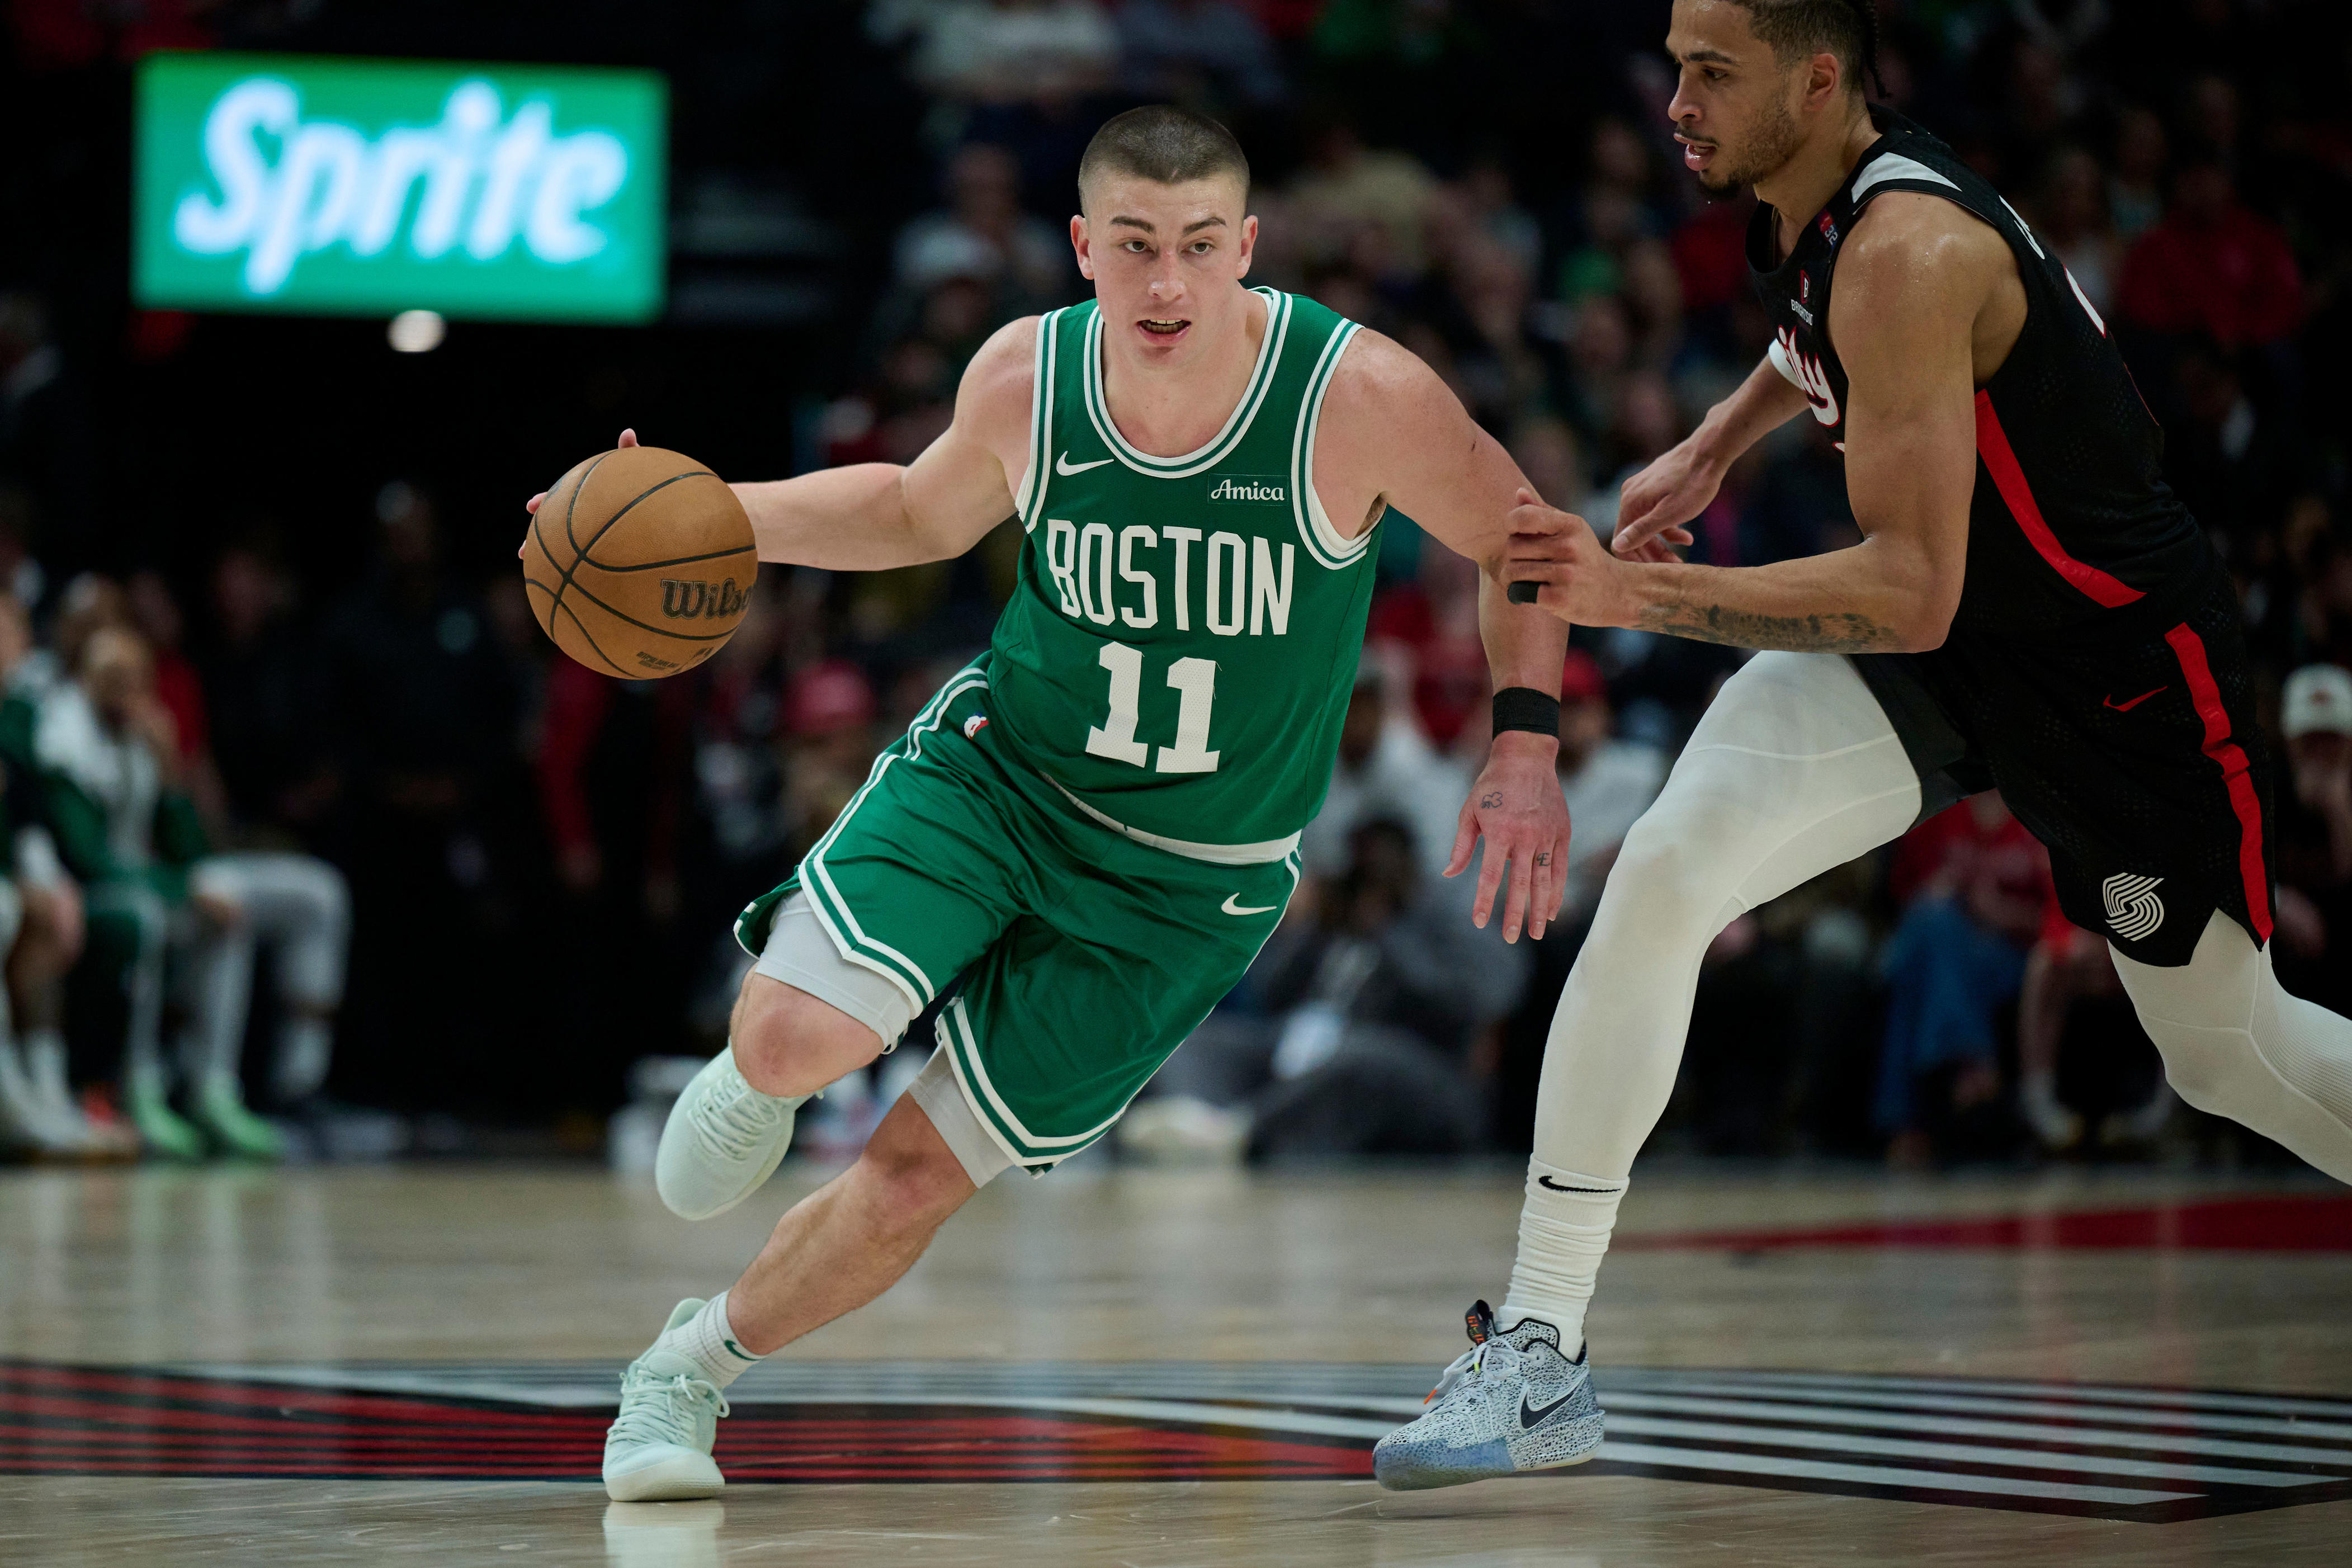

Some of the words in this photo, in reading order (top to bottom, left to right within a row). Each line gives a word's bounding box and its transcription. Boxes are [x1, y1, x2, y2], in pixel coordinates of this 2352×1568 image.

[175, 75, 627, 296] Sprite
[1825, 224, 1838, 245] 32
[1211, 479, 1285, 501] Amica
[660, 577, 755, 620] Wilso
[1047, 518, 1295, 636] BOSTON
[1085, 640, 1221, 773] 11
